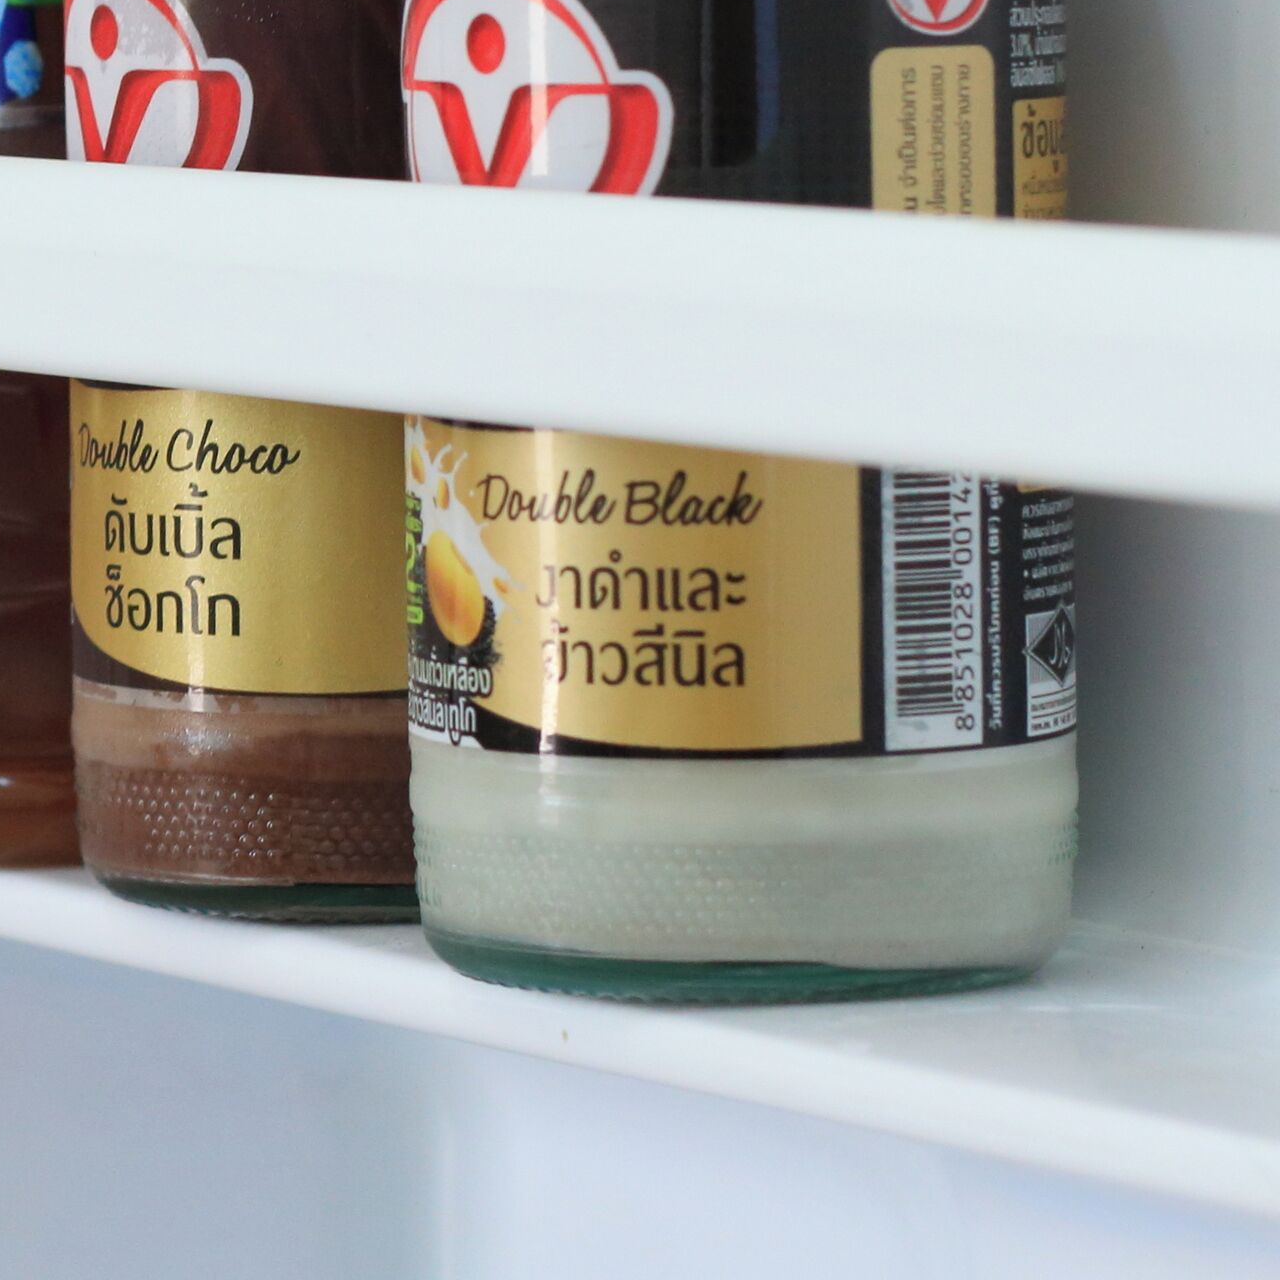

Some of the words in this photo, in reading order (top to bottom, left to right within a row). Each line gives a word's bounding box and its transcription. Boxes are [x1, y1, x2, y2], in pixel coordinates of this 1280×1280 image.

[78, 418, 160, 474] Double
[165, 418, 302, 475] Choco
[104, 482, 242, 560] ดับเบิ้ล
[476, 468, 617, 524] Double
[624, 468, 764, 528] Black
[104, 563, 241, 637] ช็อกโก
[535, 549, 746, 612] งาดำและ
[540, 619, 745, 688] ข้าวสีนิล
